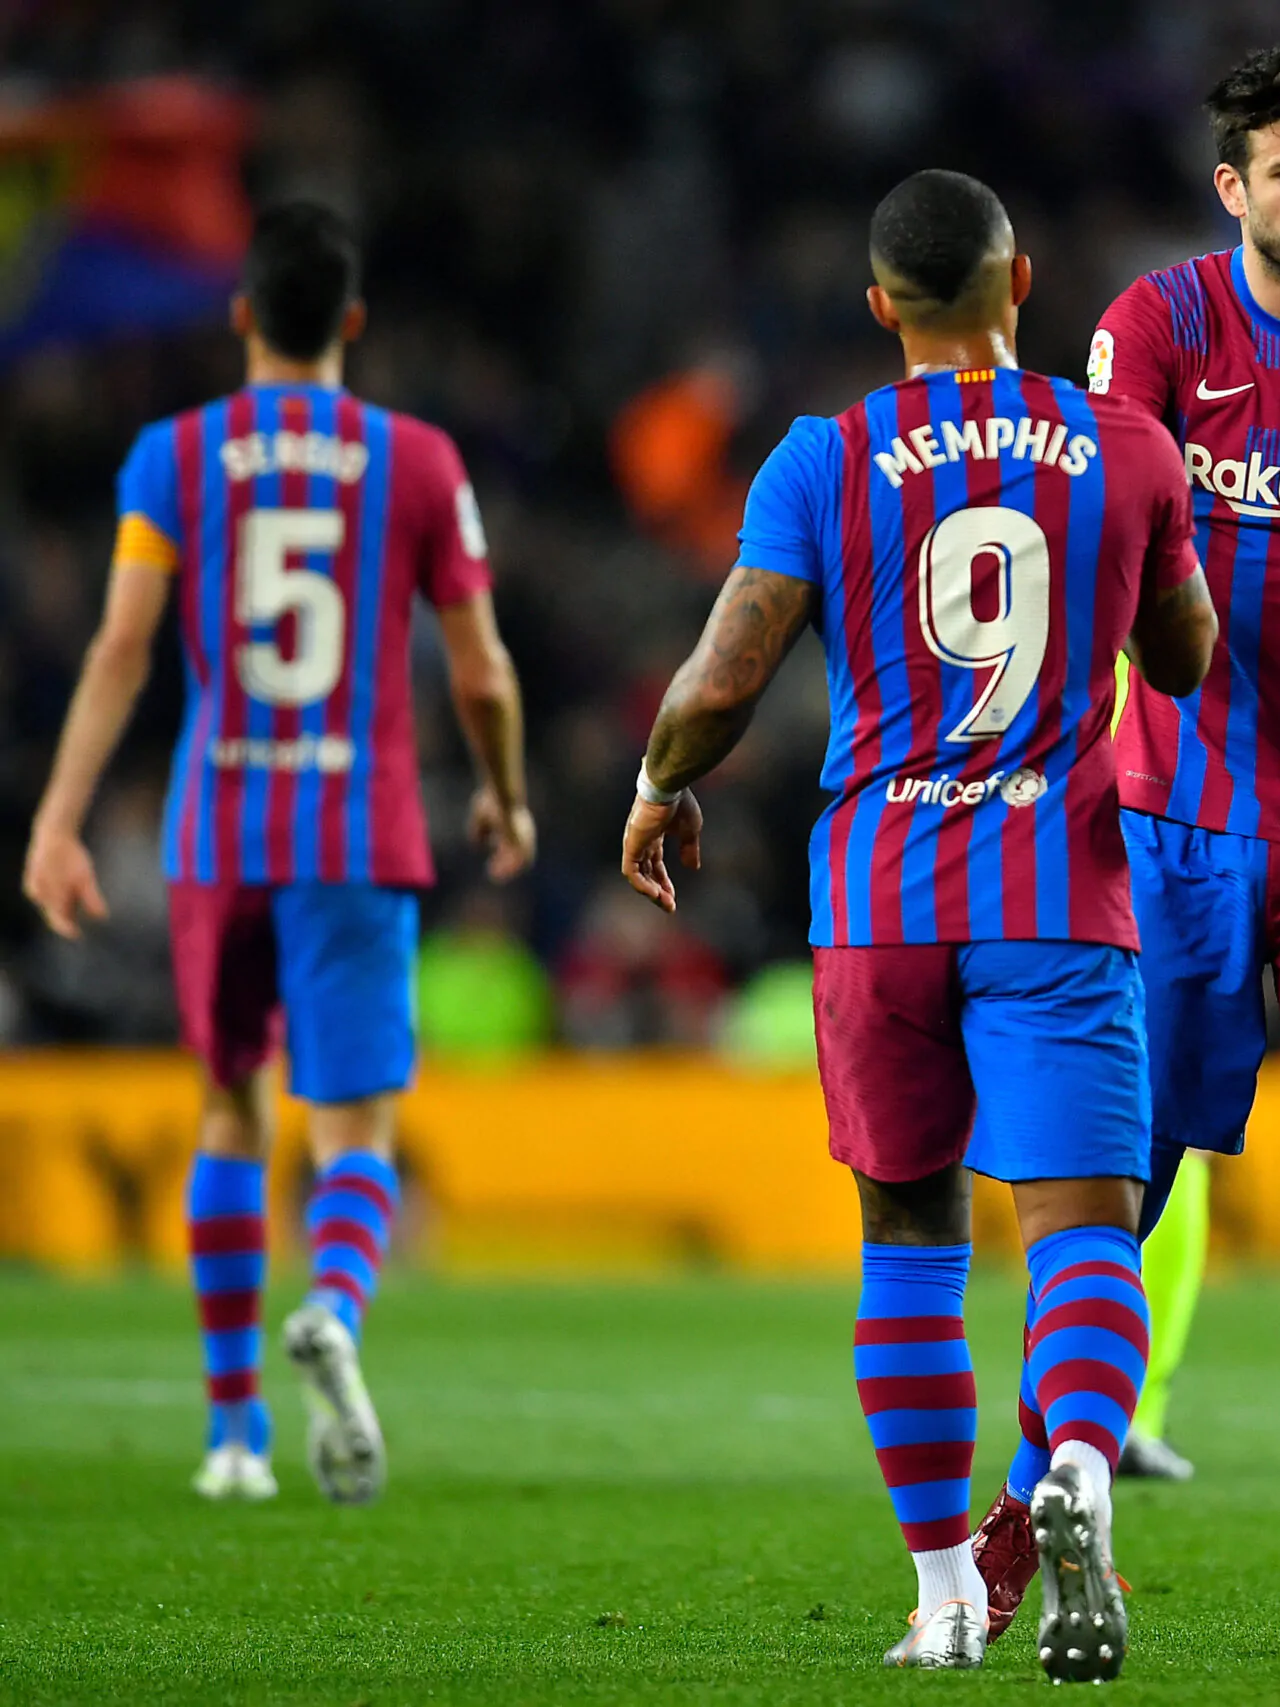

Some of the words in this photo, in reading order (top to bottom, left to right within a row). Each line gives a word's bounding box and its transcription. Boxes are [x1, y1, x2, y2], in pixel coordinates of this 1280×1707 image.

[873, 417, 1097, 489] MEMPHIS
[236, 507, 346, 707] 5
[918, 506, 1050, 743] 9
[885, 770, 1005, 808] unicef
